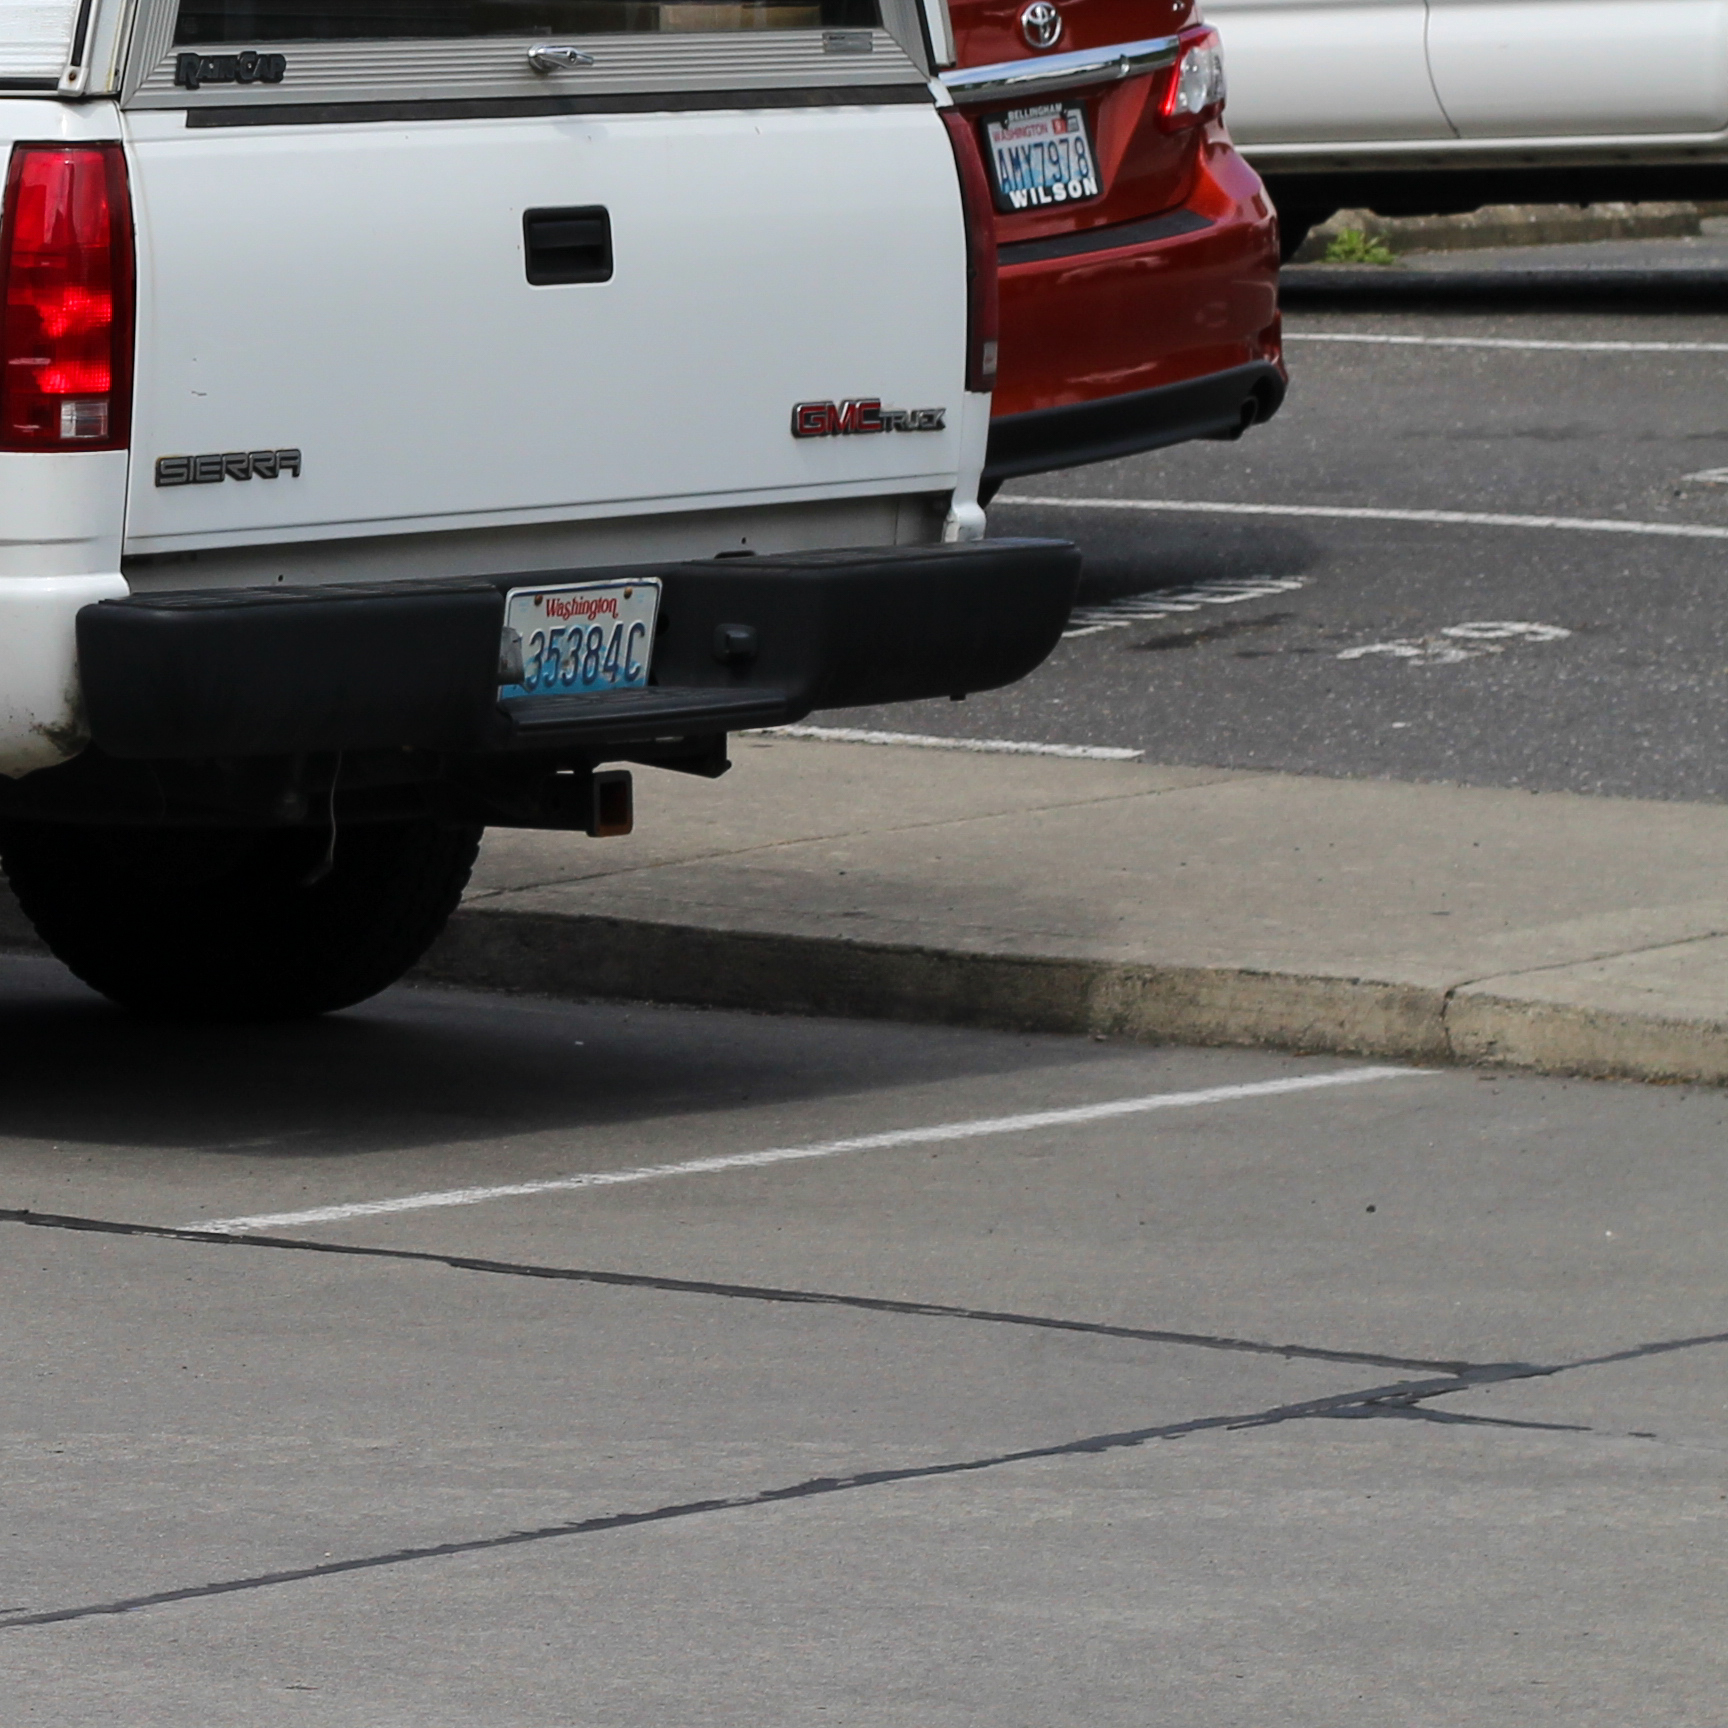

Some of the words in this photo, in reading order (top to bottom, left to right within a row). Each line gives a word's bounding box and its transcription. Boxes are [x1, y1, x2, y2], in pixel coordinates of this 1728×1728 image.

[1008, 103, 1063, 121] BELLINGHAM
[993, 123, 1048, 142] WASHINGTON
[997, 136, 1090, 194] AMY7978
[1009, 177, 1098, 209] WILSON
[791, 397, 881, 438] GMC
[155, 448, 301, 487] SIERRA
[546, 596, 619, 621] Washington
[527, 620, 646, 692] 35384C
